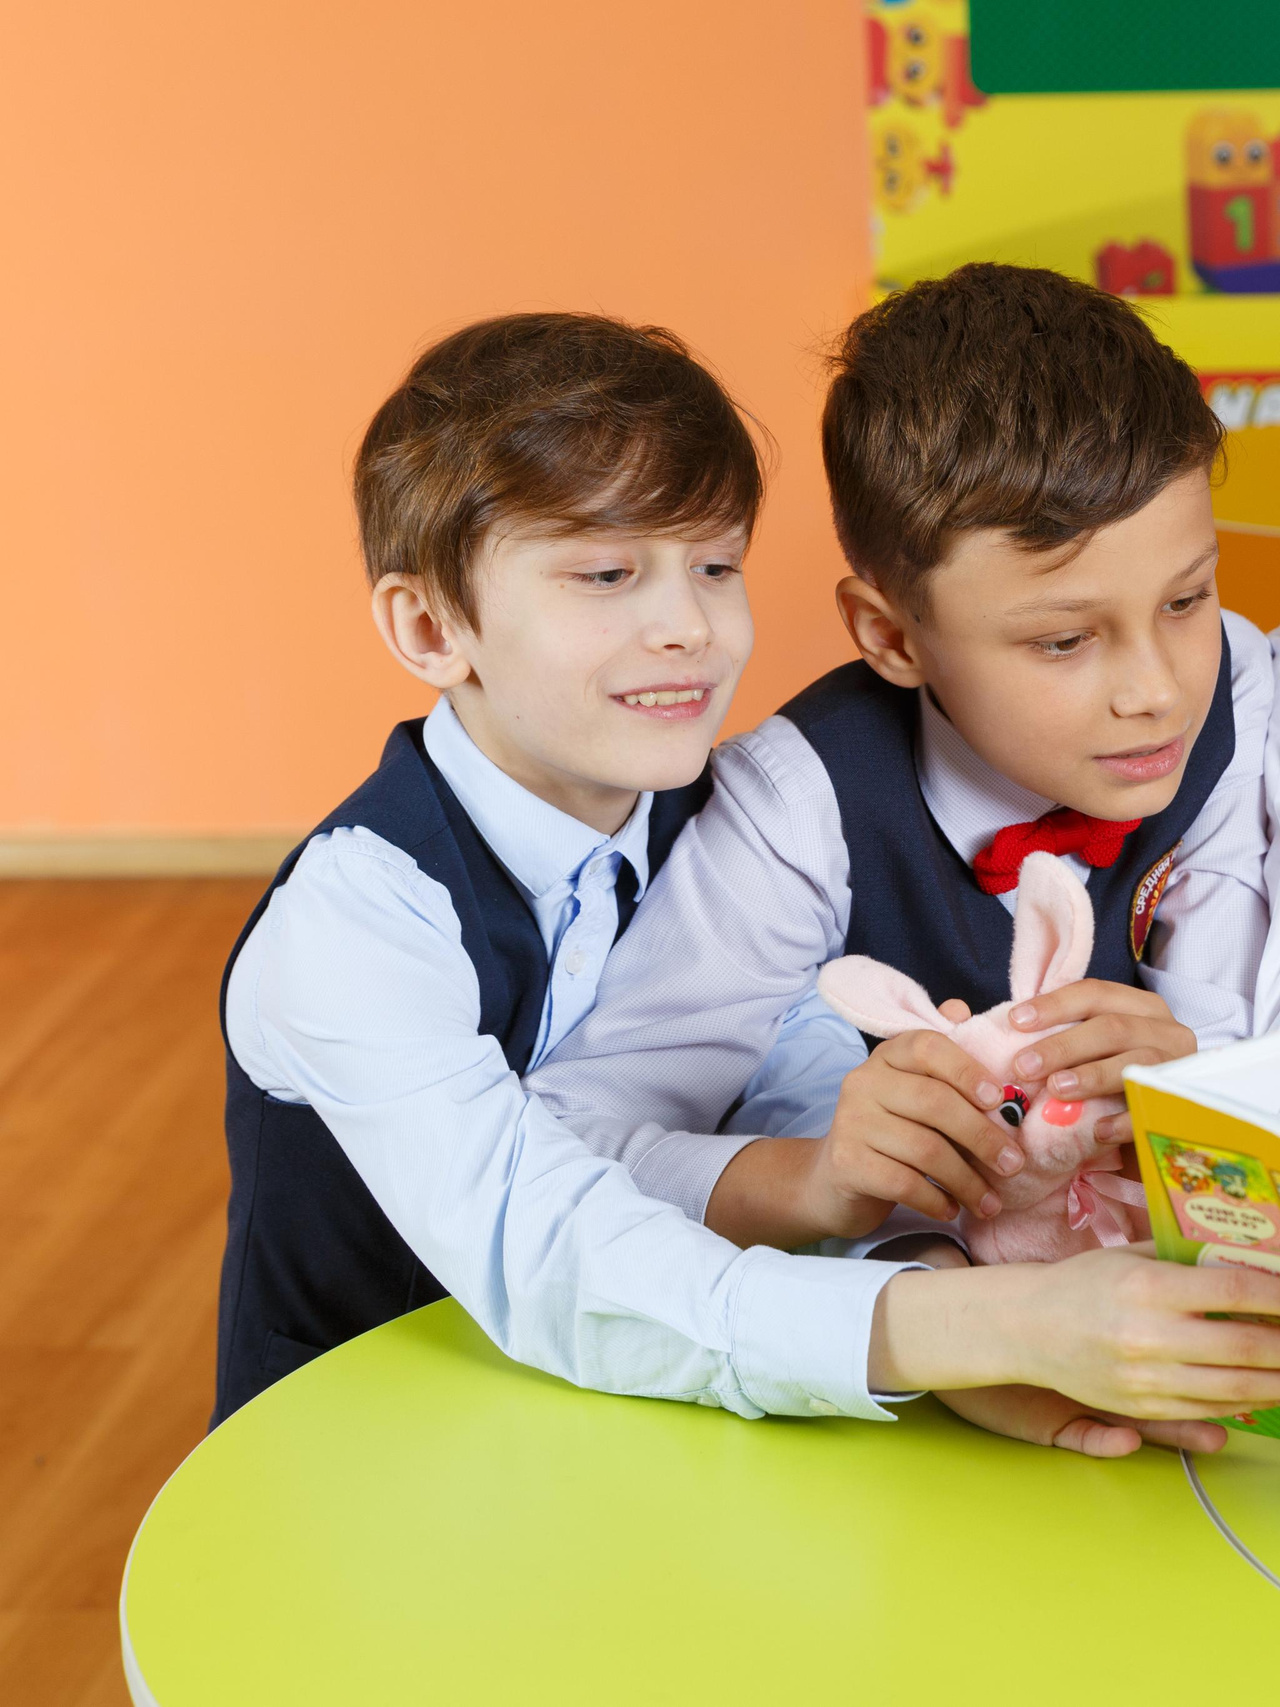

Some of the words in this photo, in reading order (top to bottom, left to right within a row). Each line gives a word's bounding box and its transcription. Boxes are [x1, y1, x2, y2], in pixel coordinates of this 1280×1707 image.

[1225, 196, 1255, 252] 1
[1135, 857, 1171, 915] СРЕДНЯЯ
[1205, 1213, 1257, 1230] СКАЗКИ
[1241, 1211, 1266, 1225] ПРО
